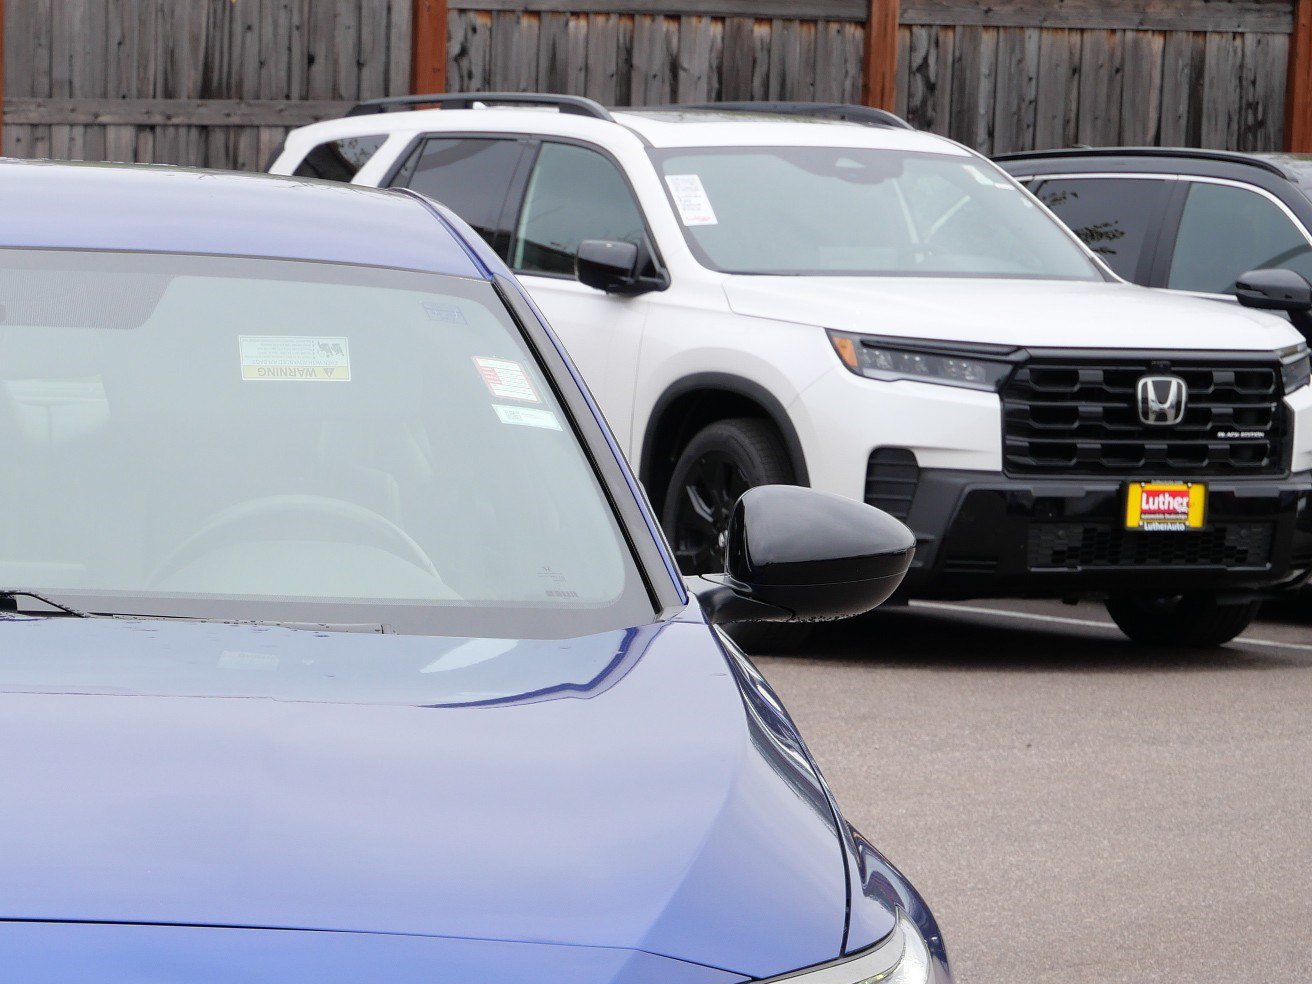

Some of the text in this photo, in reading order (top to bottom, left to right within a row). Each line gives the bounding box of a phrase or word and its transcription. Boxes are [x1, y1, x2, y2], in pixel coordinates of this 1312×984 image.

[257, 367, 317, 378] WARNING
[1141, 492, 1189, 511] Luther
[1144, 522, 1186, 531] LutherAuto
